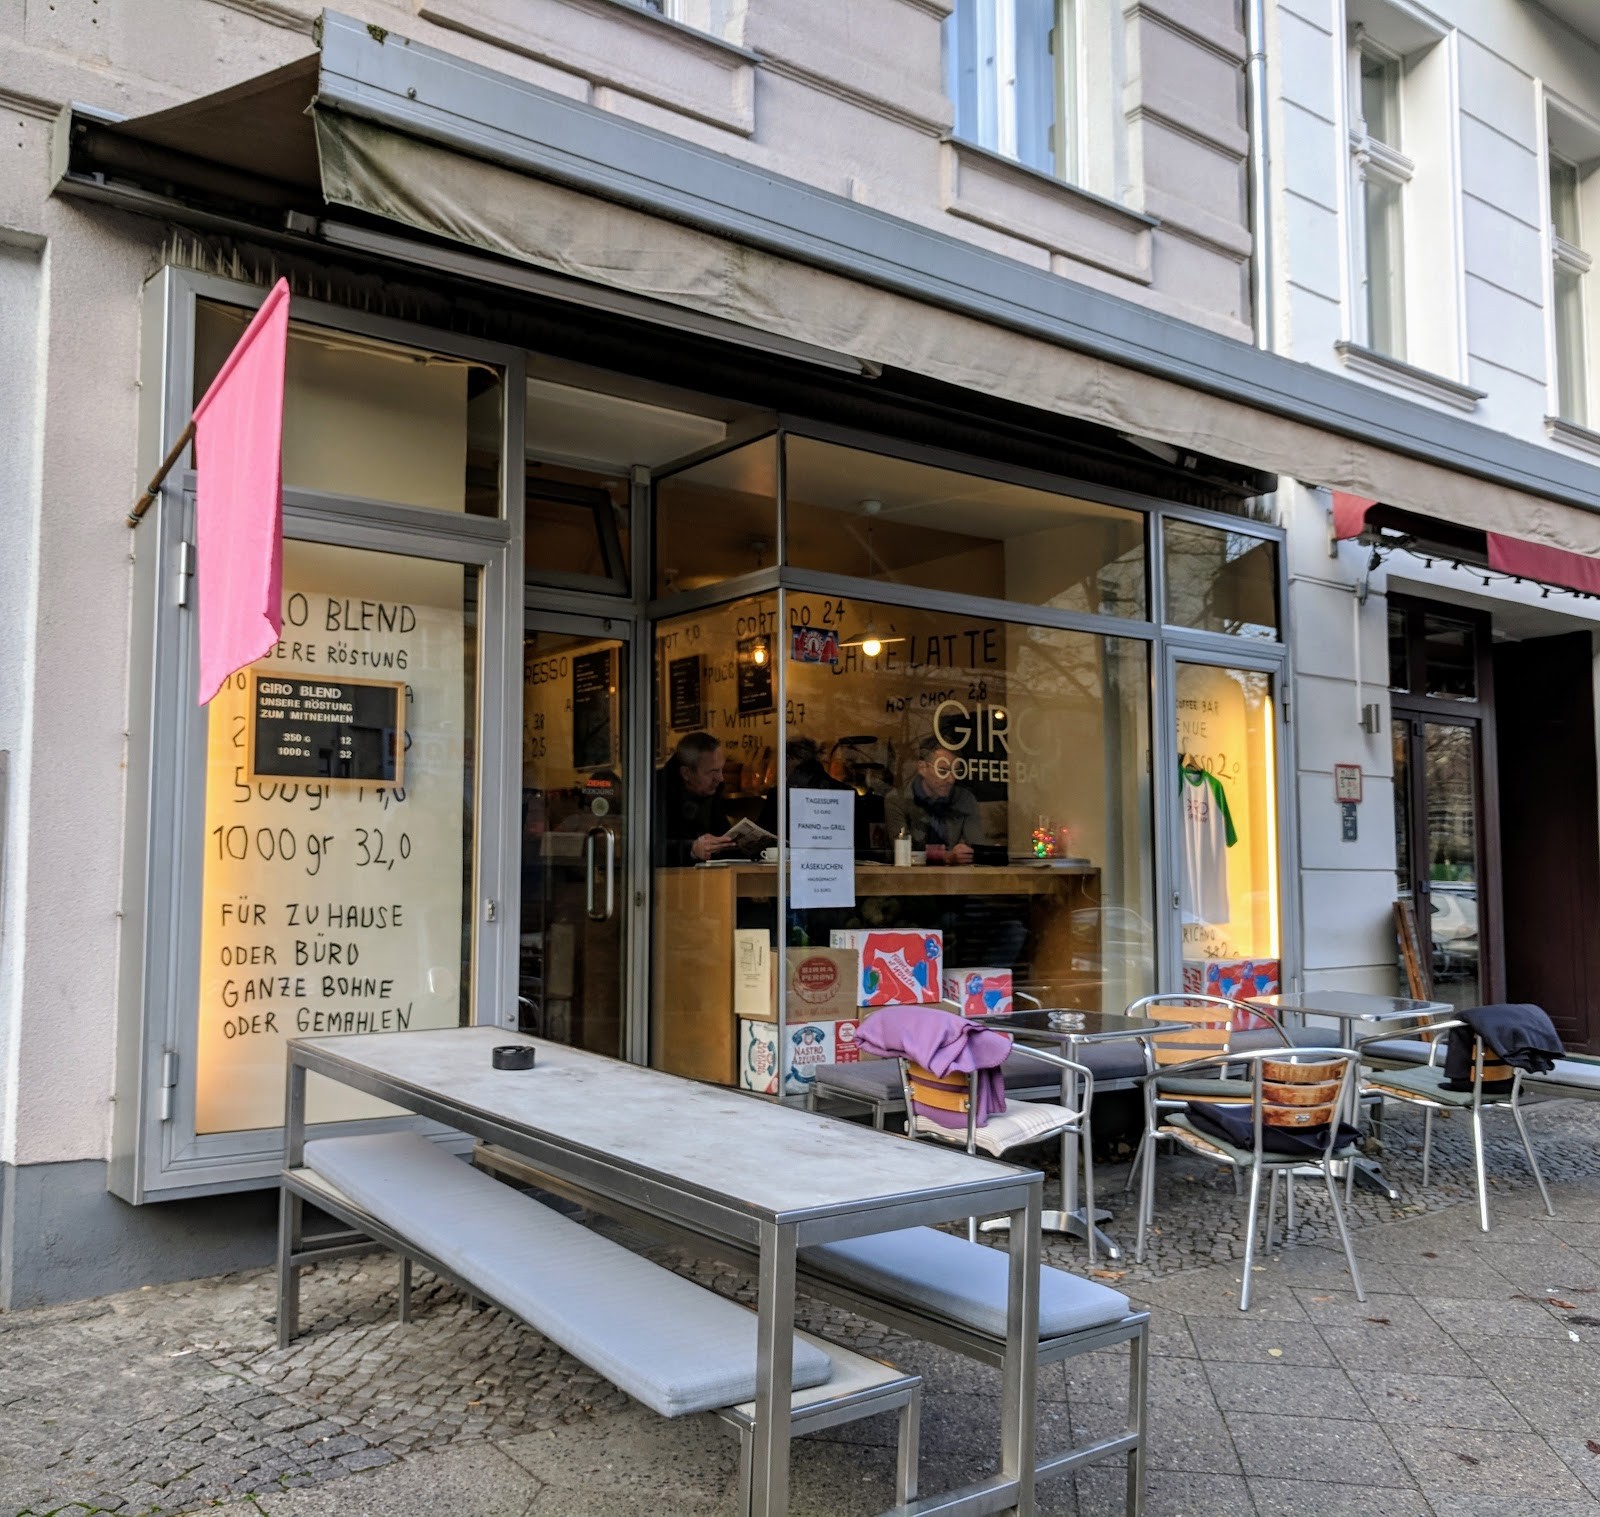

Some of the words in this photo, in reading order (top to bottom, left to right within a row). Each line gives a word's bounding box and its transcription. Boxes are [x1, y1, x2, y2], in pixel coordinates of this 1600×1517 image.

[325, 597, 417, 633] BLEND
[327, 640, 409, 670] RÖSTUNG
[909, 627, 996, 669] LATTE
[259, 682, 294, 696] GIRO
[299, 684, 342, 699] BLEND
[259, 697, 301, 709] UNSERE
[303, 697, 353, 713] RÖSTUNG
[259, 709, 284, 720] ZUM
[290, 711, 354, 724] MITNEHMEN
[277, 746, 302, 757] 1000
[339, 749, 353, 760] 32
[282, 732, 302, 744] 350
[339, 736, 352, 747] 12
[933, 756, 1011, 784] COFFEE
[355, 828, 411, 871] 32,0
[221, 895, 267, 927] FÜR
[220, 946, 277, 967] ODER
[295, 932, 359, 966] BÜRO
[222, 976, 306, 1008] GANZE
[322, 975, 394, 999] BOHNE
[223, 1011, 279, 1039] ODER
[296, 1001, 413, 1033] GEMAHLEN
[794, 1045, 824, 1056] NASTRO
